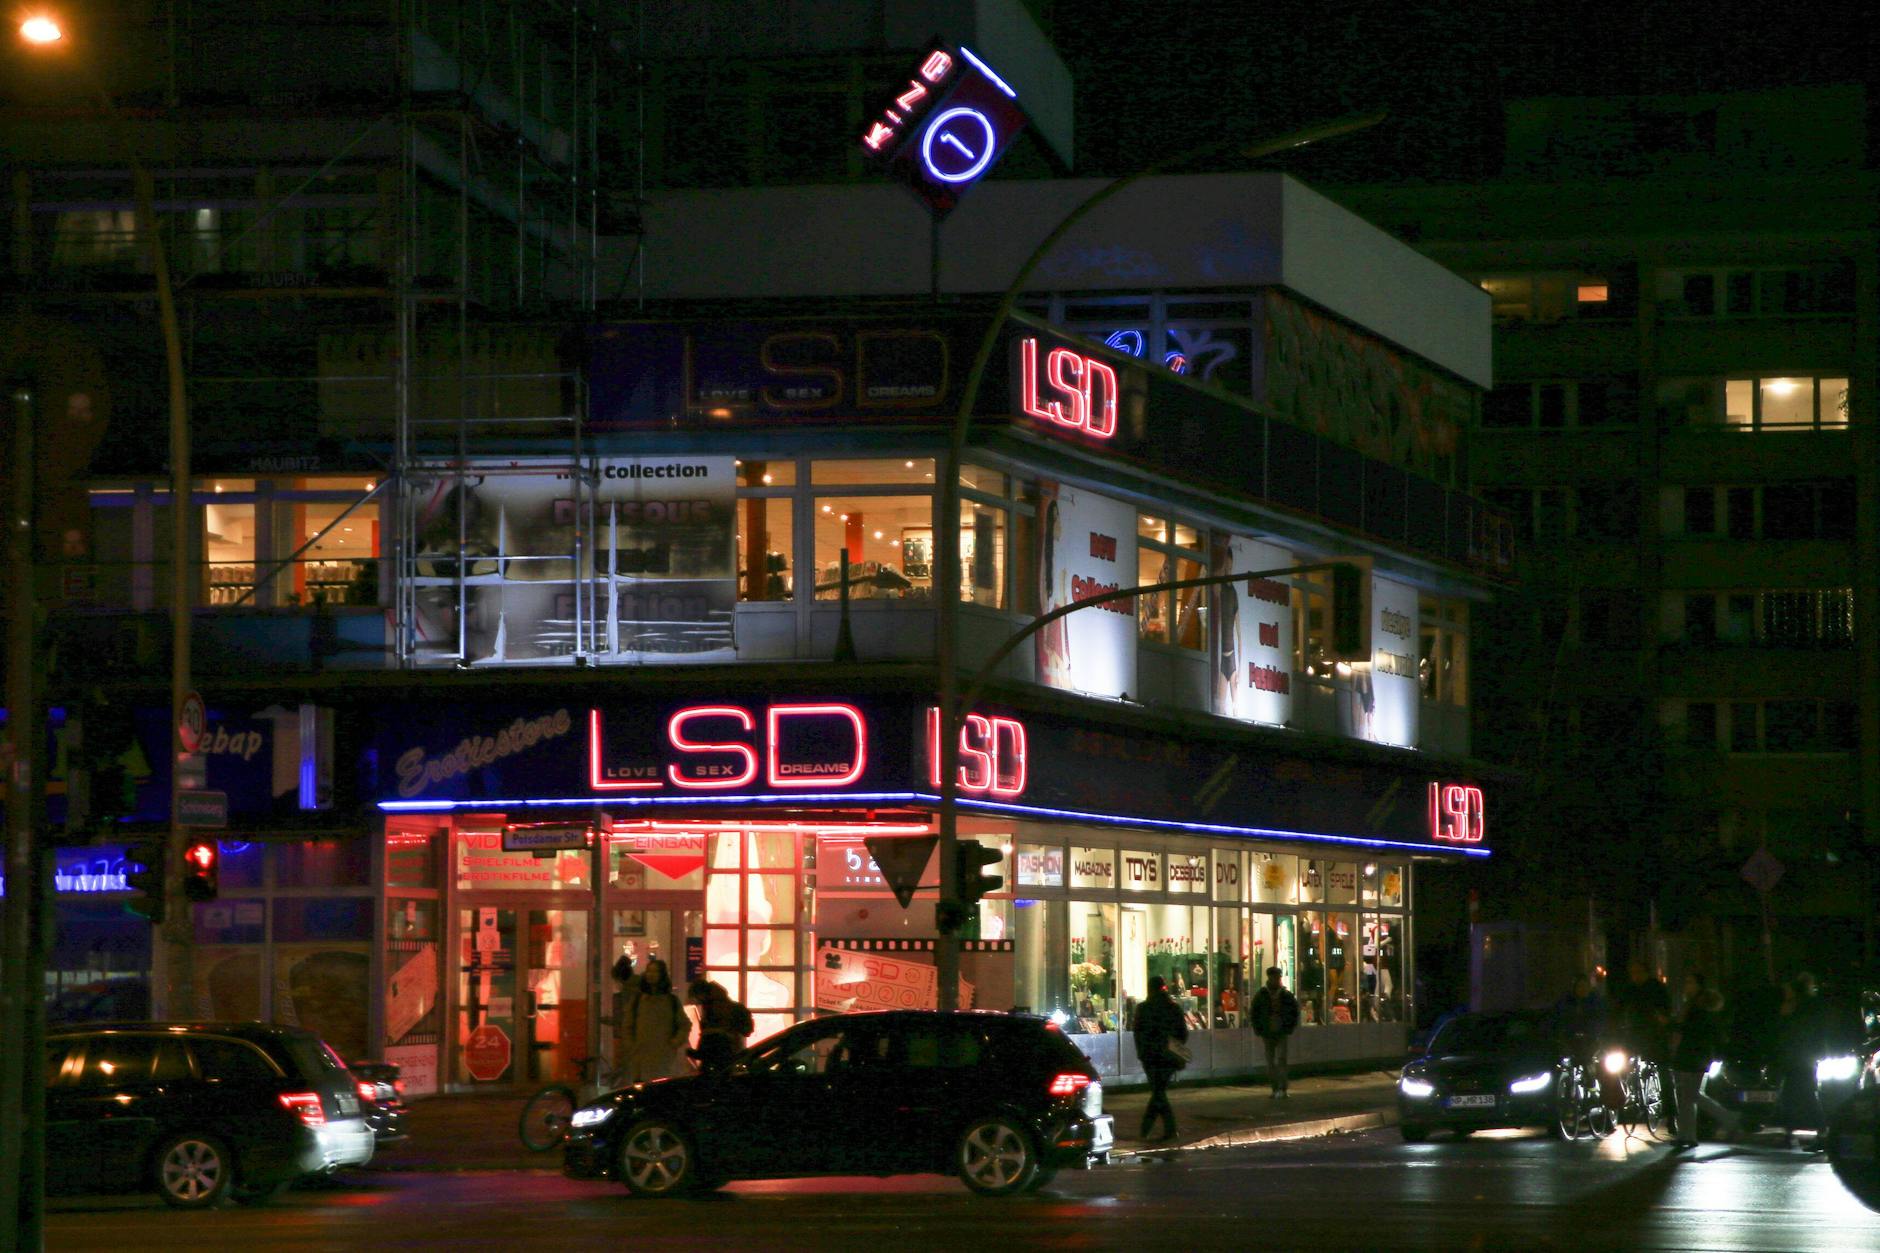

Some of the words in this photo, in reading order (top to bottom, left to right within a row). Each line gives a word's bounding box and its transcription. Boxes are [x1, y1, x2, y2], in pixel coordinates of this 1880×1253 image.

[686, 329, 951, 408] LSD
[1022, 336, 1118, 438] LSD
[605, 464, 708, 480] Collection
[201, 725, 262, 761] ebap
[590, 704, 865, 789] LSD
[606, 766, 658, 778] LOVE
[695, 764, 733, 776] SEX
[779, 762, 850, 774] DREAMS
[1428, 781, 1484, 842] LSD
[635, 837, 703, 849] EINGAN
[462, 856, 542, 868] SPIELFILME
[1020, 855, 1062, 873] FASHION
[1074, 860, 1112, 877] MAGAZINE
[1126, 857, 1157, 882] TOYS
[462, 872, 550, 882] EROTIKFILME
[1169, 864, 1205, 882] DESSOUS
[1216, 862, 1237, 885] DVD
[475, 1035, 501, 1049] 24
